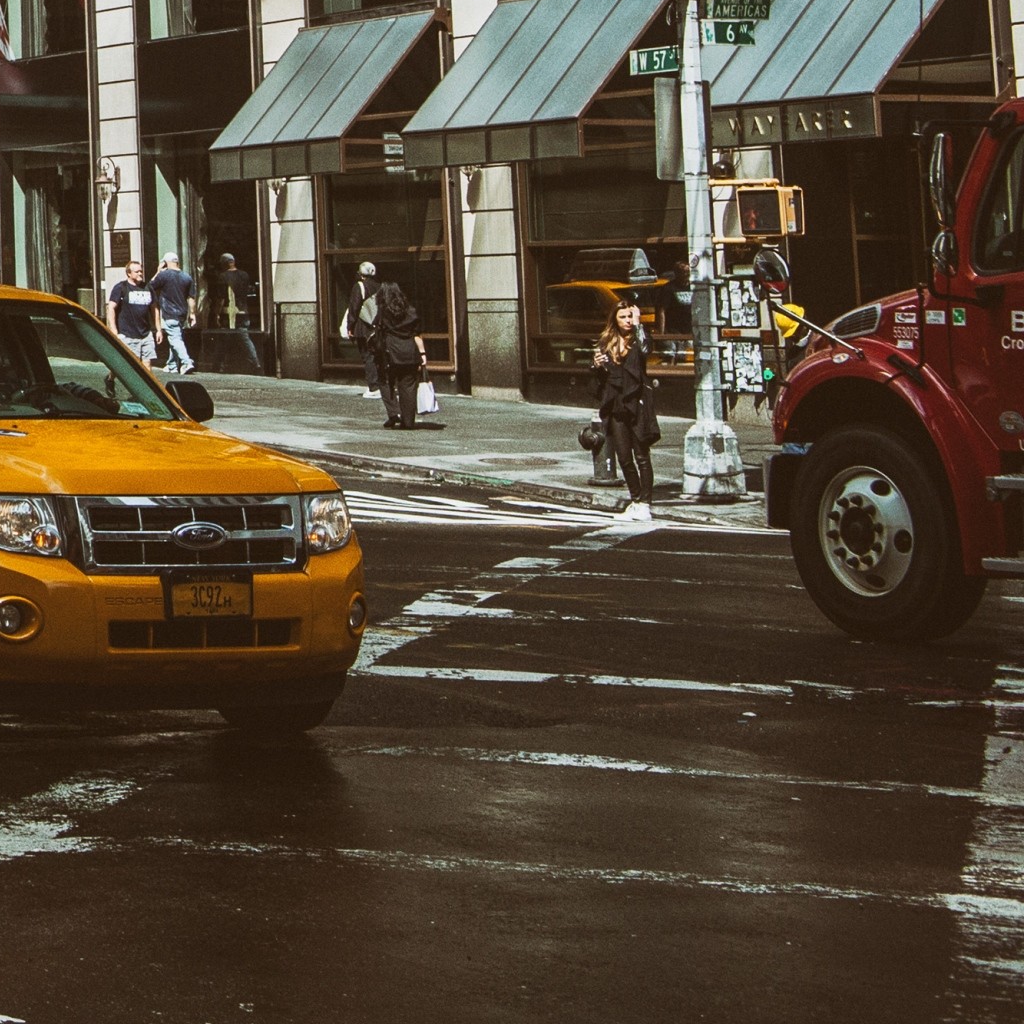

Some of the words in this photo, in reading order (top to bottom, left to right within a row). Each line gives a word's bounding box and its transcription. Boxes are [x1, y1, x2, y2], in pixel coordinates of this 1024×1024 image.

[715, 4, 767, 17] AMERICAS
[727, 24, 735, 42] 6
[639, 52, 648, 71] W
[653, 50, 666, 70] 57
[105, 596, 163, 606] ESCAPE
